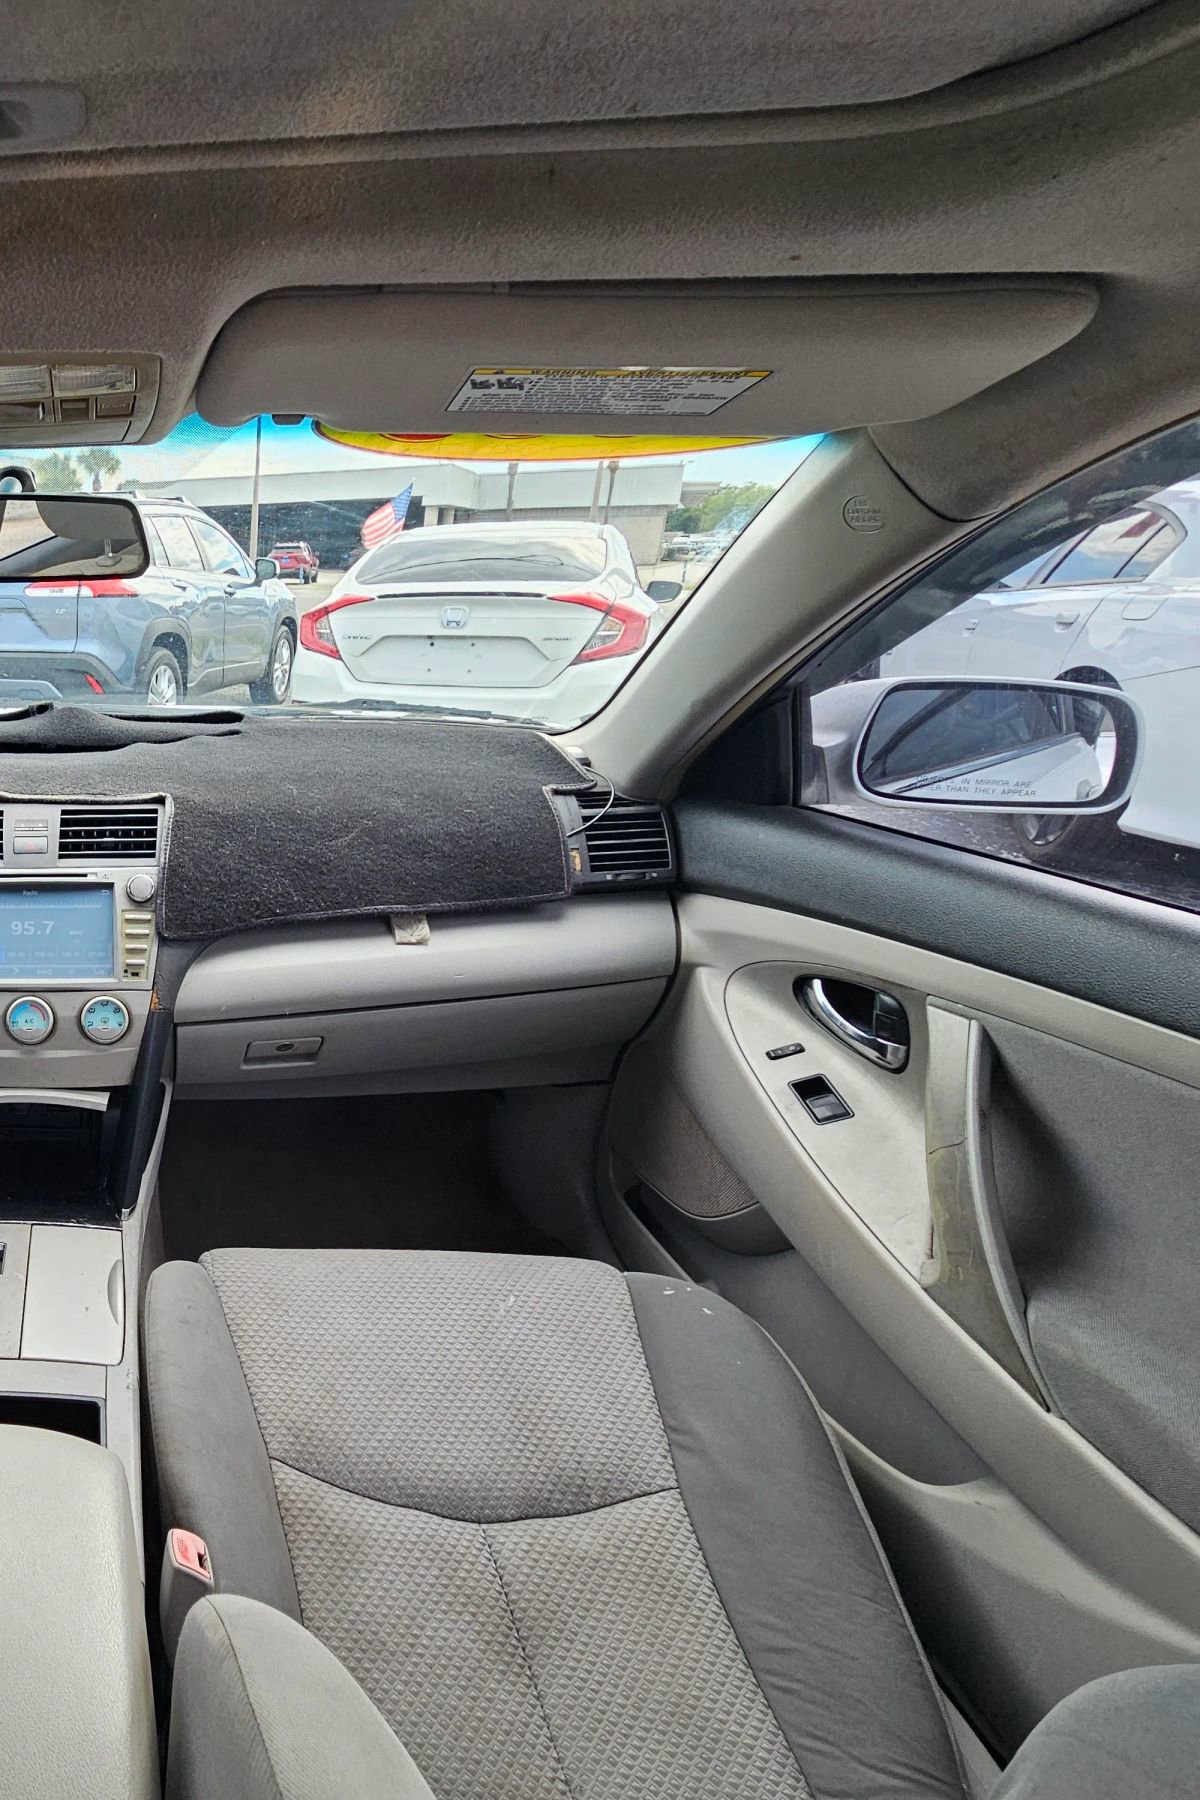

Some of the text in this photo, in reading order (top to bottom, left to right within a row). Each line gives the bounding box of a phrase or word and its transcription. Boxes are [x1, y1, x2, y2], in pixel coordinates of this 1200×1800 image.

[975, 778, 1010, 787] MIRROR
[1014, 780, 1033, 788] ARE
[946, 785, 972, 794] THAN
[974, 787, 997, 795] THEY
[1001, 789, 1036, 797] APPEAR
[10, 920, 55, 936] 95.7
